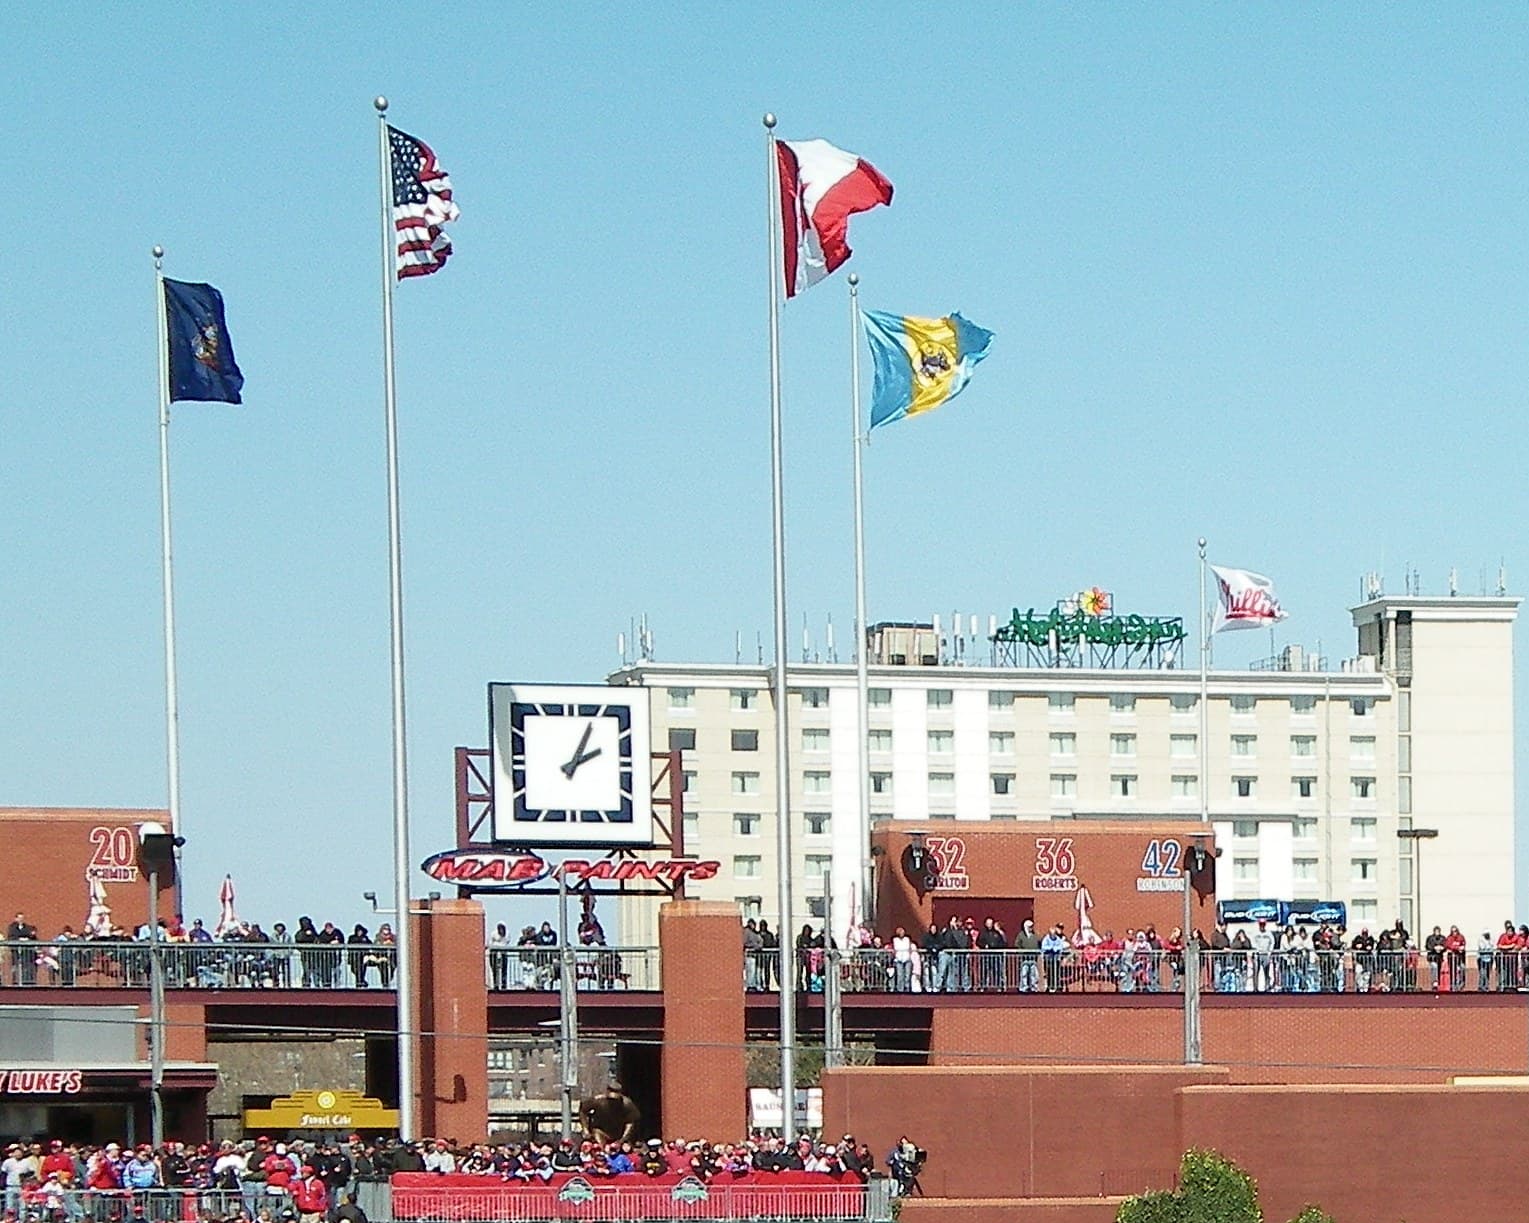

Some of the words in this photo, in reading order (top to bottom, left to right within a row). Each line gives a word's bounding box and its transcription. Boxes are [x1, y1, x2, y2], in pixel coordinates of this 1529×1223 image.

[90, 827, 134, 867] 20
[926, 838, 966, 875] 32
[1036, 838, 1075, 876] 36
[1142, 839, 1181, 876] 42
[432, 858, 545, 880] MAB
[553, 859, 721, 881] PAINTS
[925, 877, 968, 889] CARLTON
[1035, 877, 1076, 889] ROBERTS
[7, 1071, 82, 1093] LUKE'S
